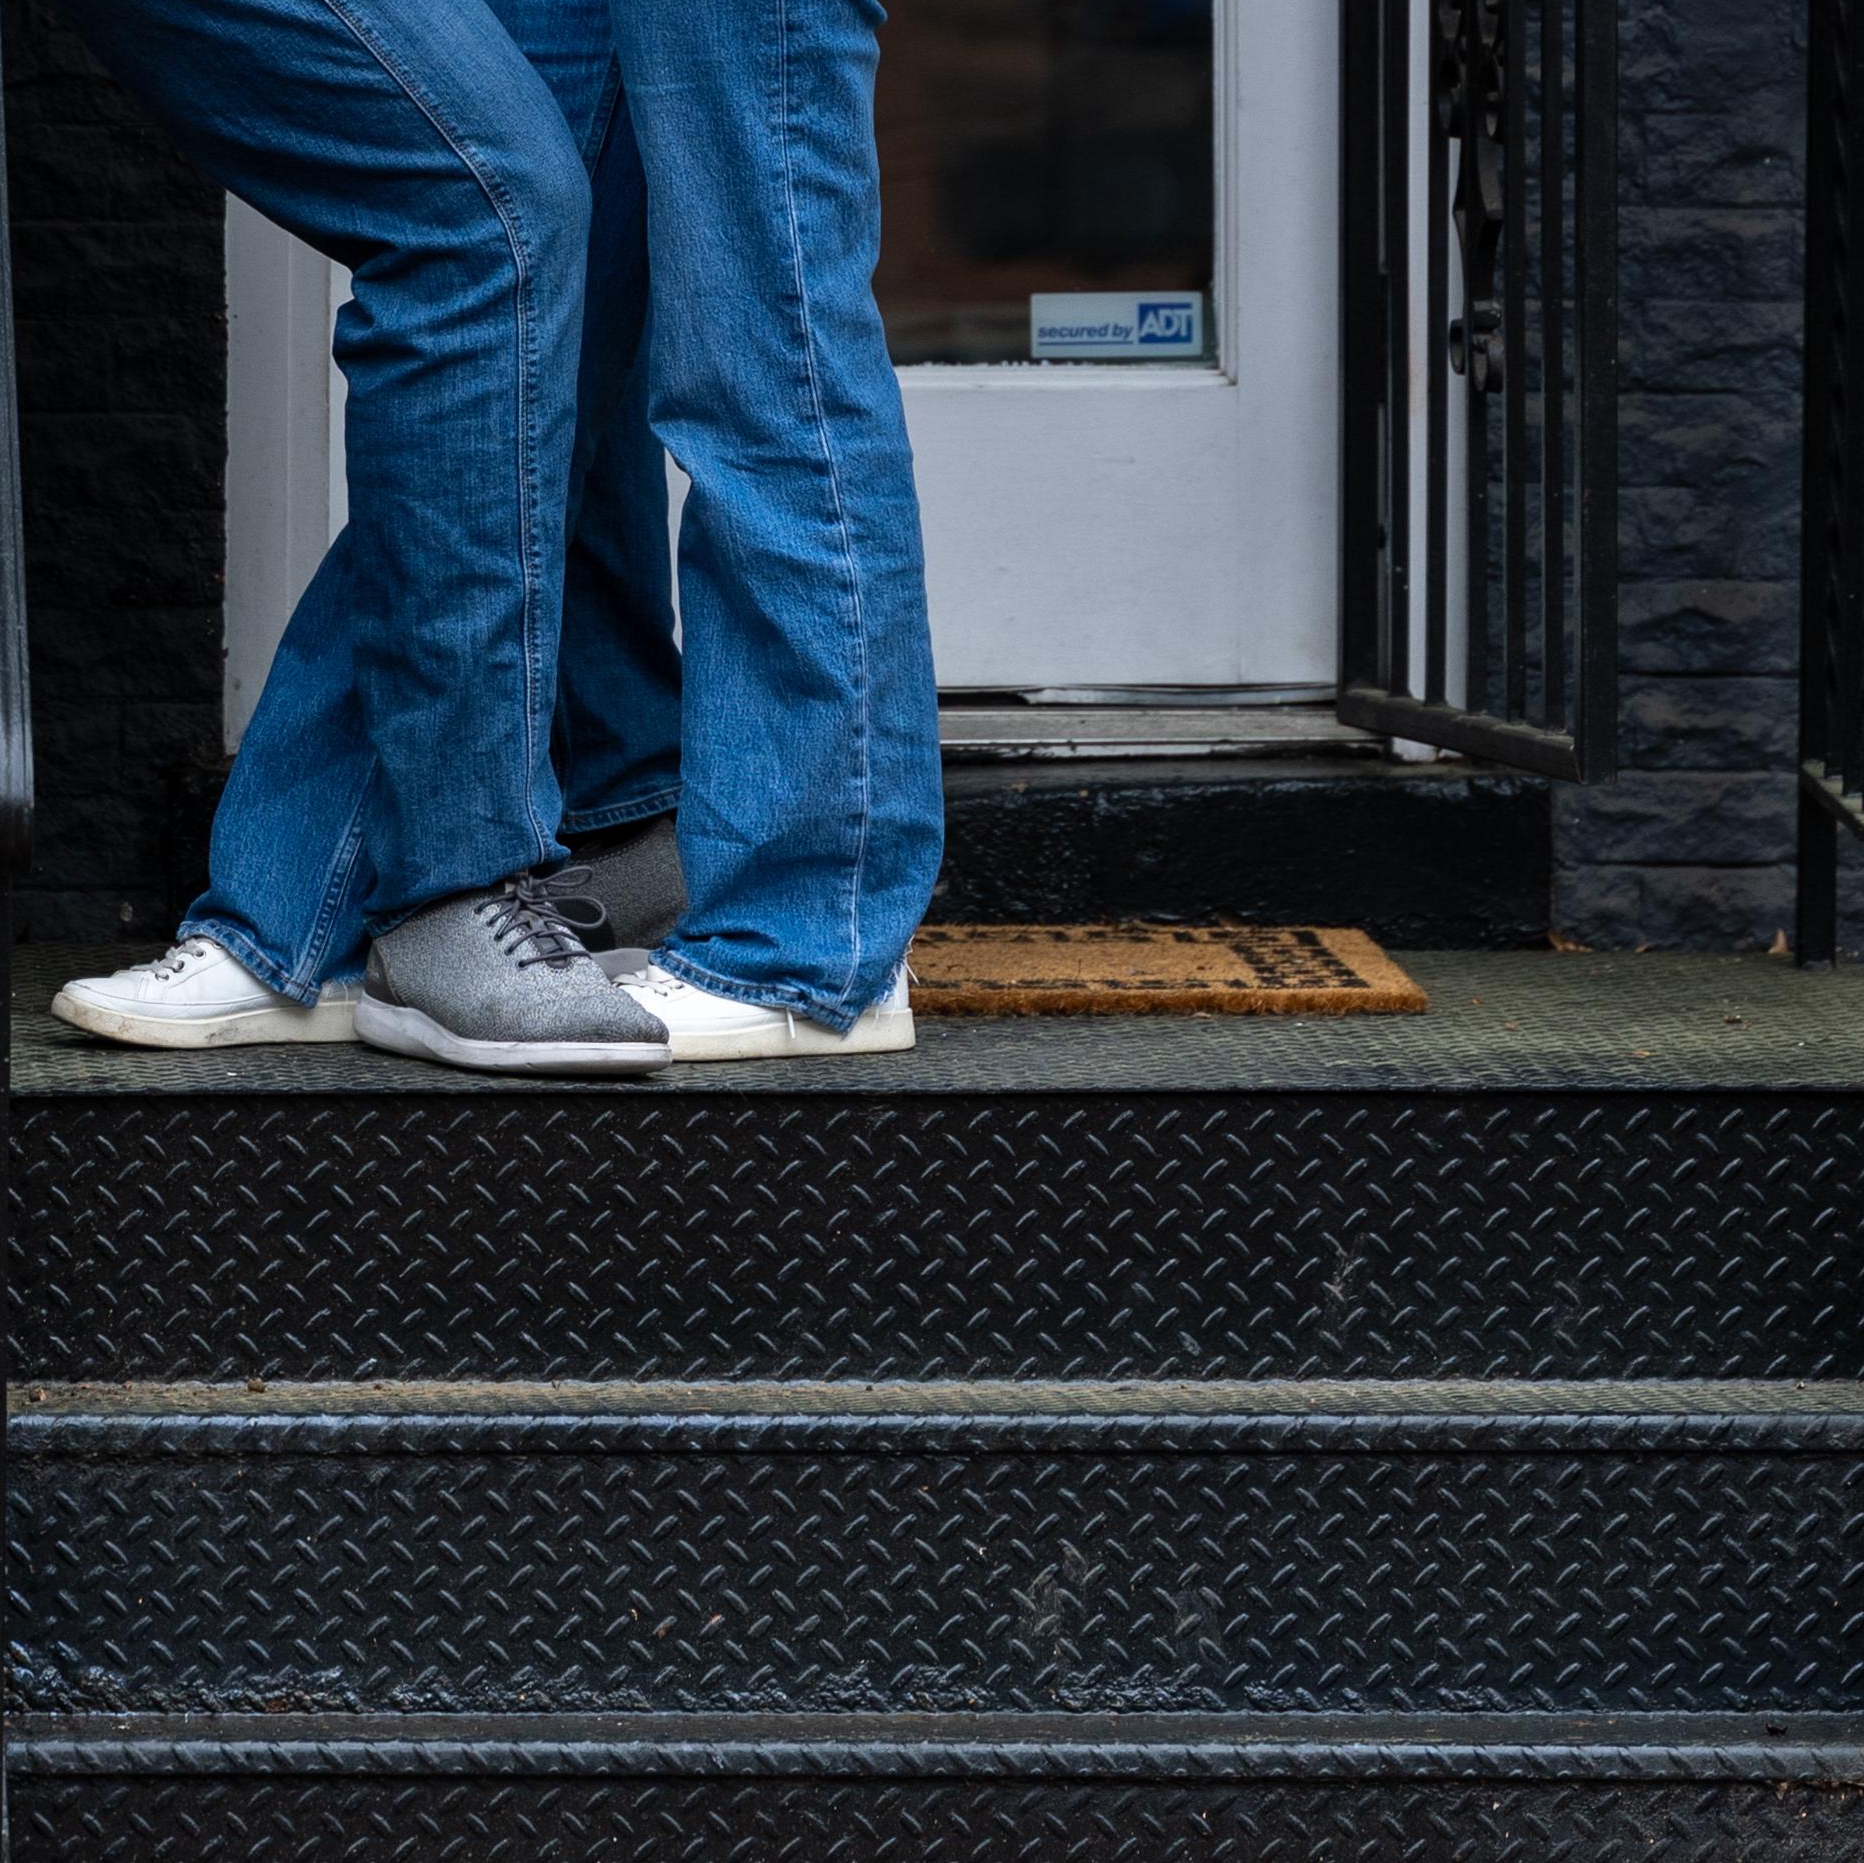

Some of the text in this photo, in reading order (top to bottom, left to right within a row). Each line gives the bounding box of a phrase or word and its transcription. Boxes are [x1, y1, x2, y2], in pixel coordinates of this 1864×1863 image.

[1038, 322, 1134, 341] secured by
[1140, 307, 1193, 338] ADT
